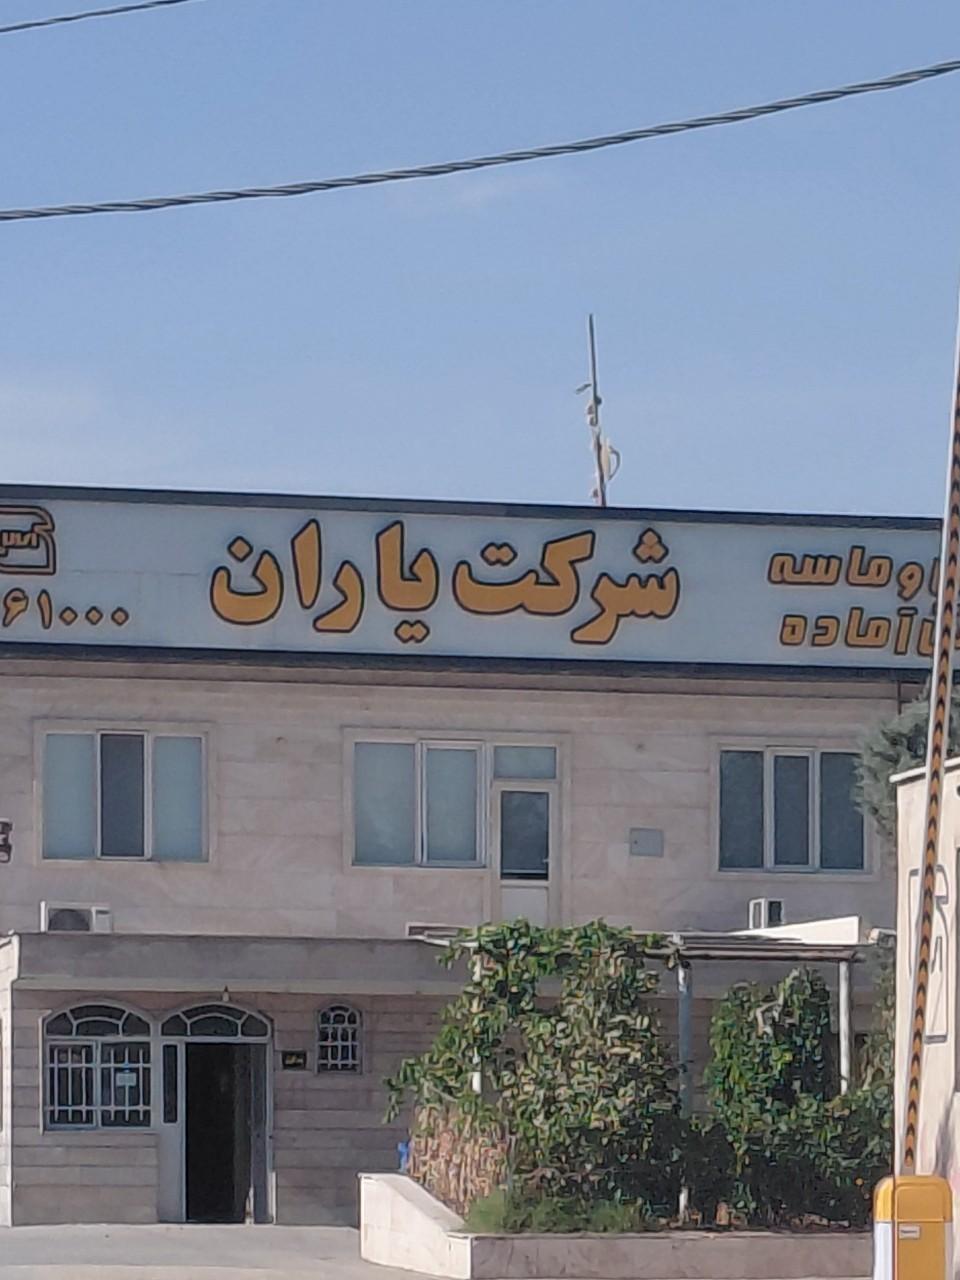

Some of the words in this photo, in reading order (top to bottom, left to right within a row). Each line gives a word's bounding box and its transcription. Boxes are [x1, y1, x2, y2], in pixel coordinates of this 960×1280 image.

[210, 519, 439, 643] یاران
[452, 528, 681, 645] شرکت
[767, 546, 894, 589] ماسه
[897, 561, 925, 602] و
[779, 605, 916, 656] آماده
